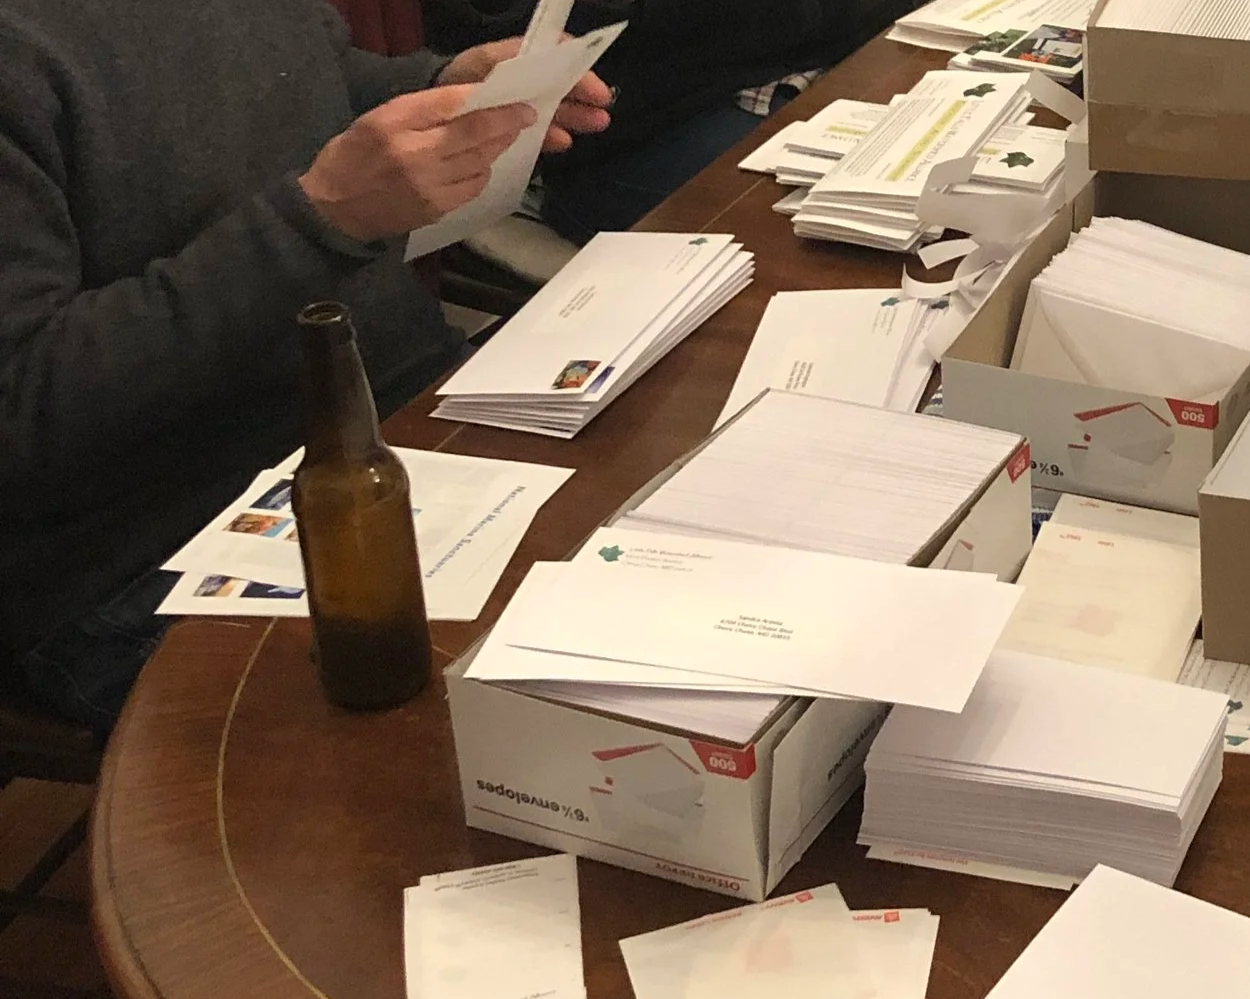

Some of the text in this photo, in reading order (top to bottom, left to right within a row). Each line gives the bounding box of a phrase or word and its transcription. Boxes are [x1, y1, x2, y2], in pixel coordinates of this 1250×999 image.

[1181, 410, 1205, 424] 500
[493, 485, 527, 514] National
[425, 539, 472, 578] Sanctuaries
[708, 755, 738, 773] 500
[475, 778, 561, 814] envelopes
[696, 871, 741, 893] Office
